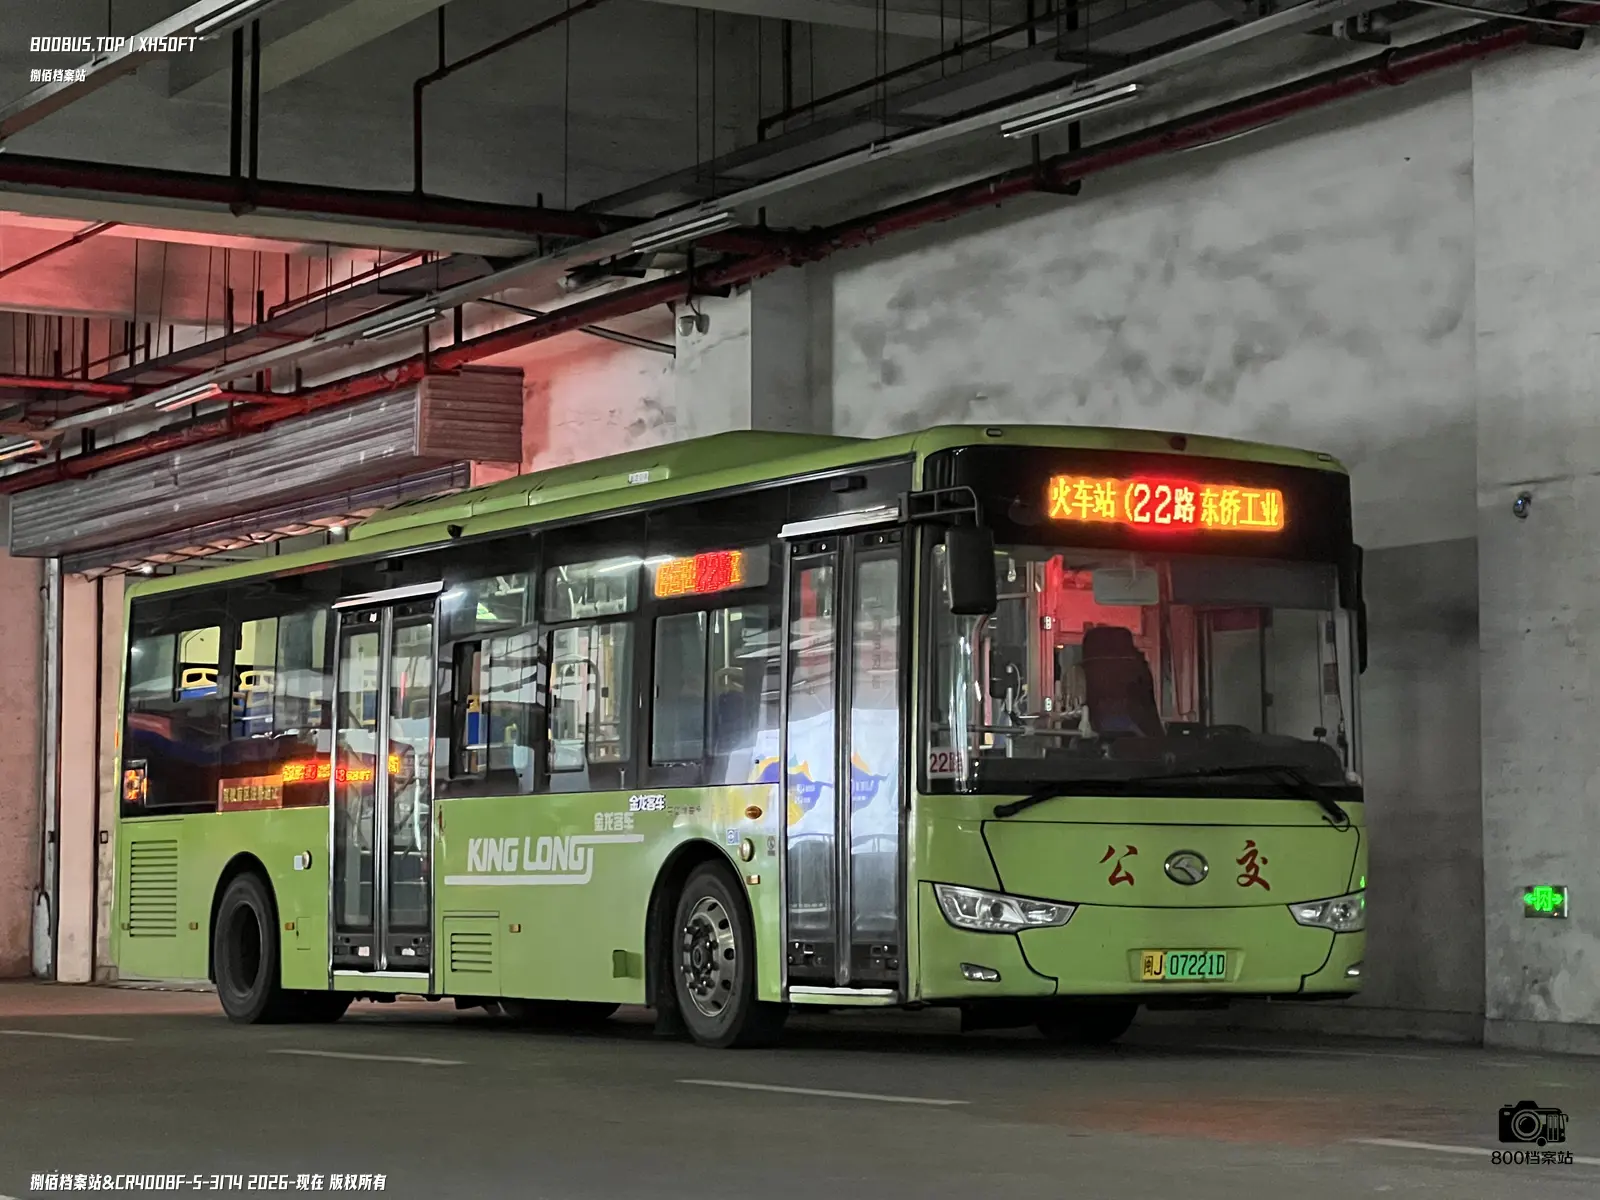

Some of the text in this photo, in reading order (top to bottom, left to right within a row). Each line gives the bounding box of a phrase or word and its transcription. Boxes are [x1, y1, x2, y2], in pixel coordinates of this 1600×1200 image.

[1050, 477, 1117, 519] 火车站
[467, 836, 585, 872] KING LONG
[1099, 844, 1138, 886] 公
